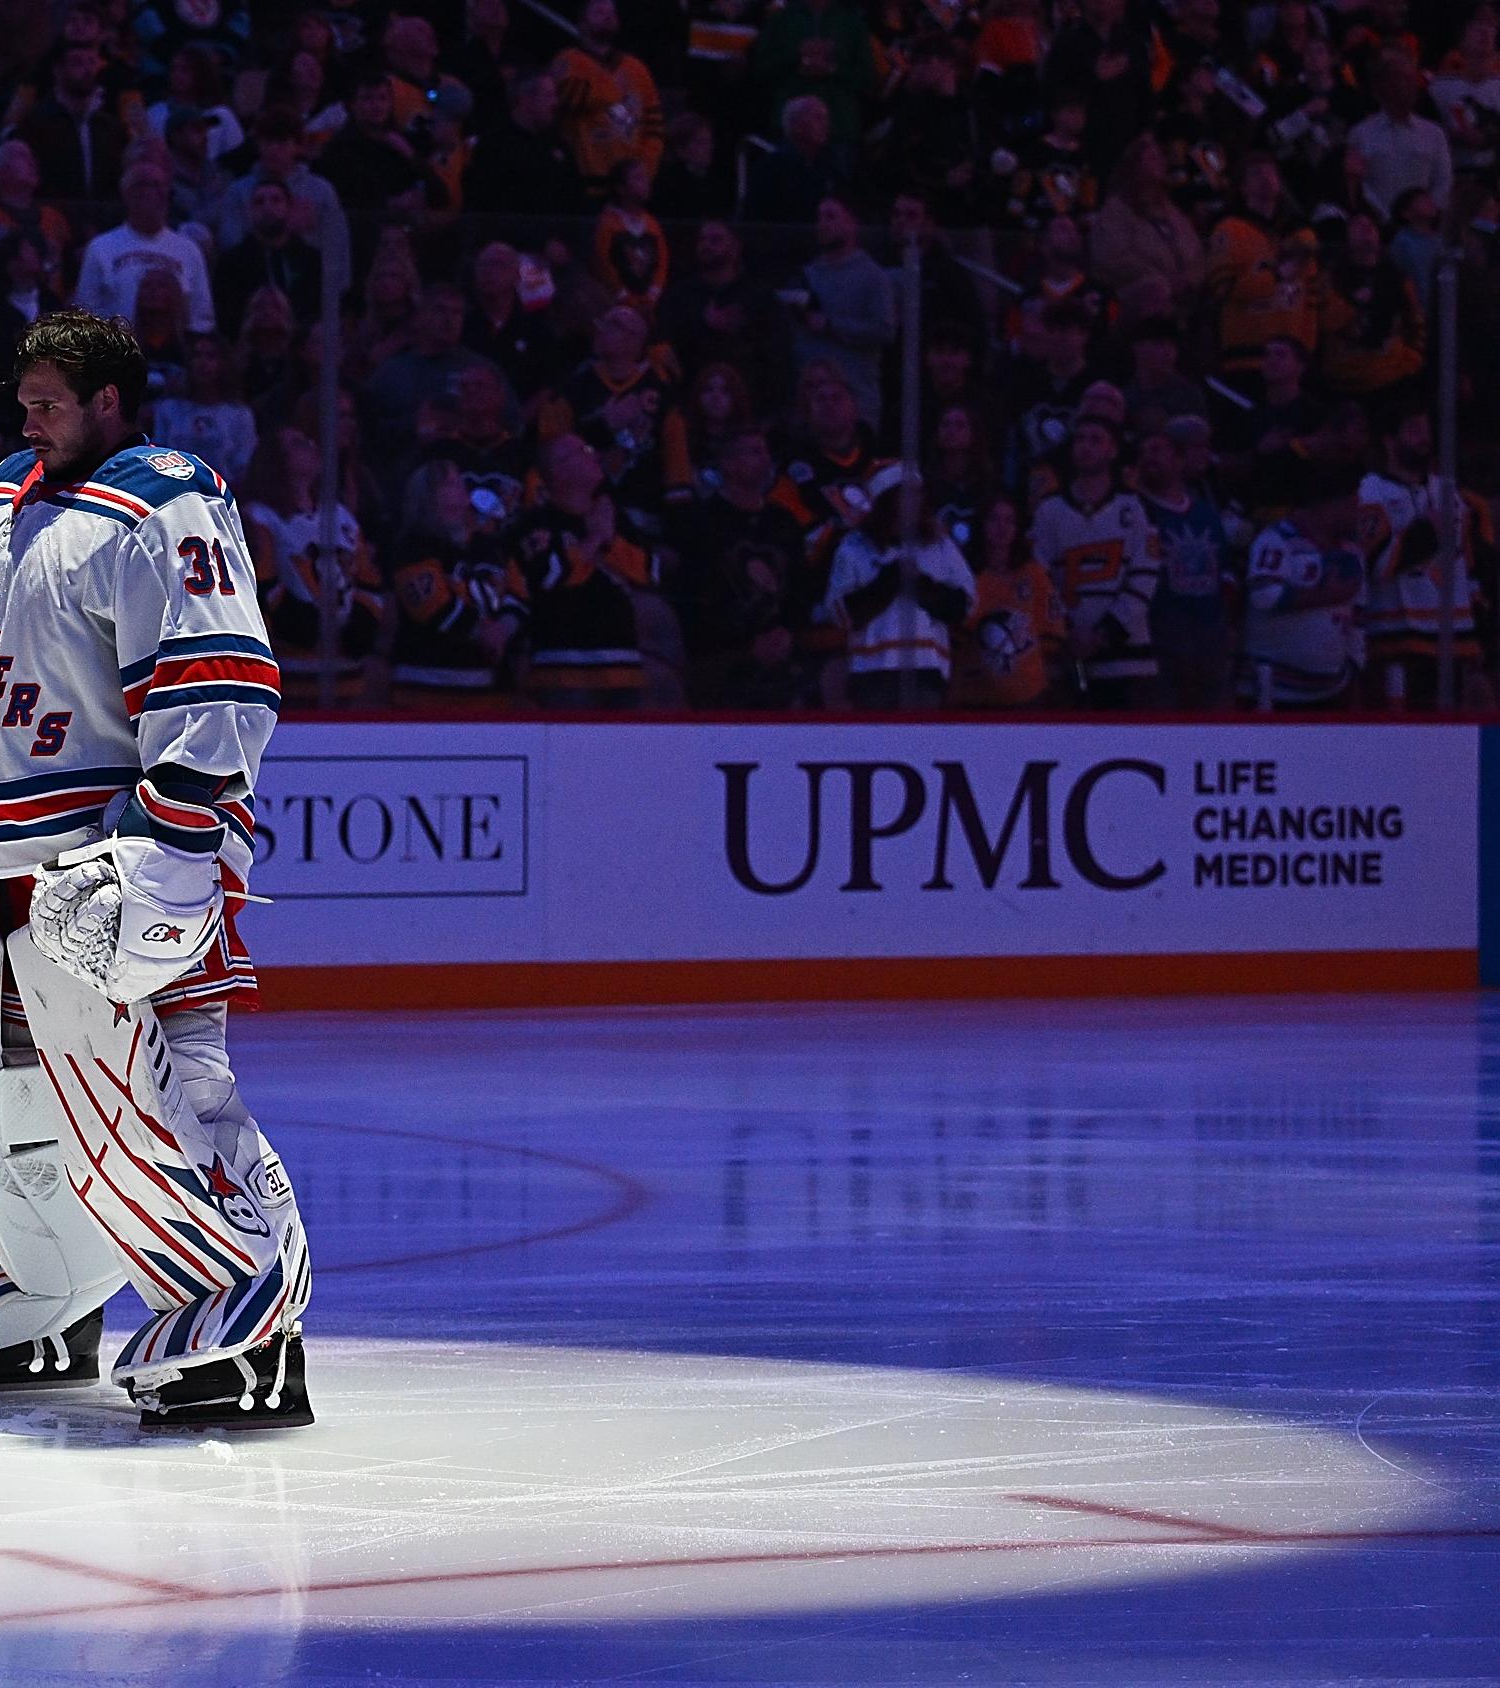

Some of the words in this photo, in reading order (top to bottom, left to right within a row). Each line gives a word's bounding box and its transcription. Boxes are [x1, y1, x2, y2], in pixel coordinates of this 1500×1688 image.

[176, 535, 236, 597] 31
[1194, 761, 1277, 796] LIFE
[714, 757, 1168, 896] UPMC
[1193, 805, 1404, 841] CHANGING
[1194, 851, 1384, 888] MEDICINE
[264, 1168, 285, 1194] 31
